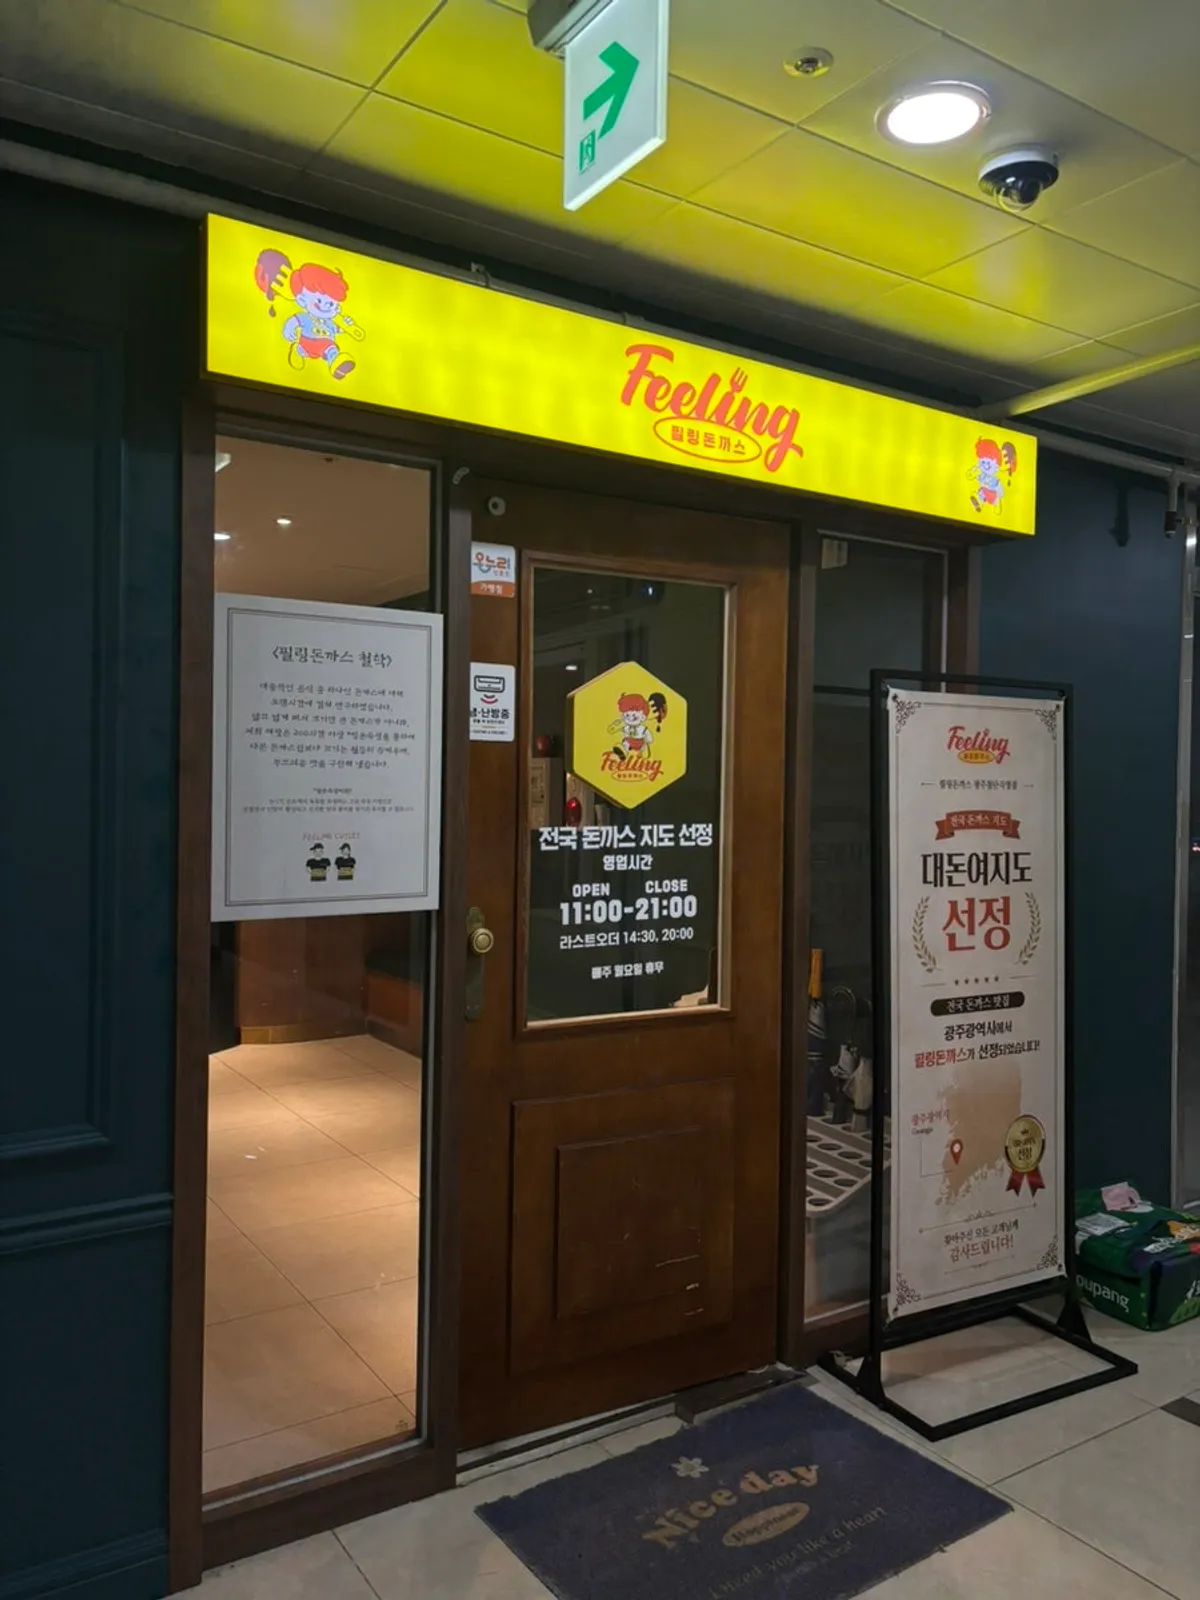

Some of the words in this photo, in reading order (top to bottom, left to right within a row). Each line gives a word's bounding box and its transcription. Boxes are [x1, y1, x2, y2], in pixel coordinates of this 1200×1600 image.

[620, 343, 804, 472] Feeling
[671, 424, 746, 455] 필링돈까스
[946, 725, 1011, 765] Feeling
[600, 750, 664, 783] Feeling
[538, 826, 578, 851] 전국
[581, 825, 636, 849] 돈까스
[640, 824, 675, 848] 지도
[678, 823, 714, 847] 선정
[602, 854, 653, 872] 영업시간
[921, 851, 1033, 888] 대돈여지도
[572, 883, 611, 898] OPEN
[644, 879, 689, 895] CLOSE
[559, 895, 698, 926] 11:00-21:00
[942, 895, 1012, 952] 선정
[559, 930, 620, 950] 라스트오더
[661, 926, 694, 942] 20:00
[614, 962, 643, 978] 월요일
[645, 960, 665, 975] 휴무
[946, 1000, 965, 1012] 전국
[966, 997, 992, 1011] 돈까스
[993, 994, 1011, 1008] 맛집
[944, 1019, 1013, 1041] 광주광역시에서
[914, 1046, 976, 1069] 필링돈까스가
[978, 1039, 1041, 1060] 선정되었습니다!
[948, 1233, 1014, 1263] 감사드립니다!
[1075, 1274, 1131, 1313] oupang
[641, 1487, 739, 1552] Nice
[739, 1463, 821, 1495] day
[797, 1535, 830, 1556] like
[832, 1528, 843, 1539] a
[842, 1504, 889, 1534] heart
